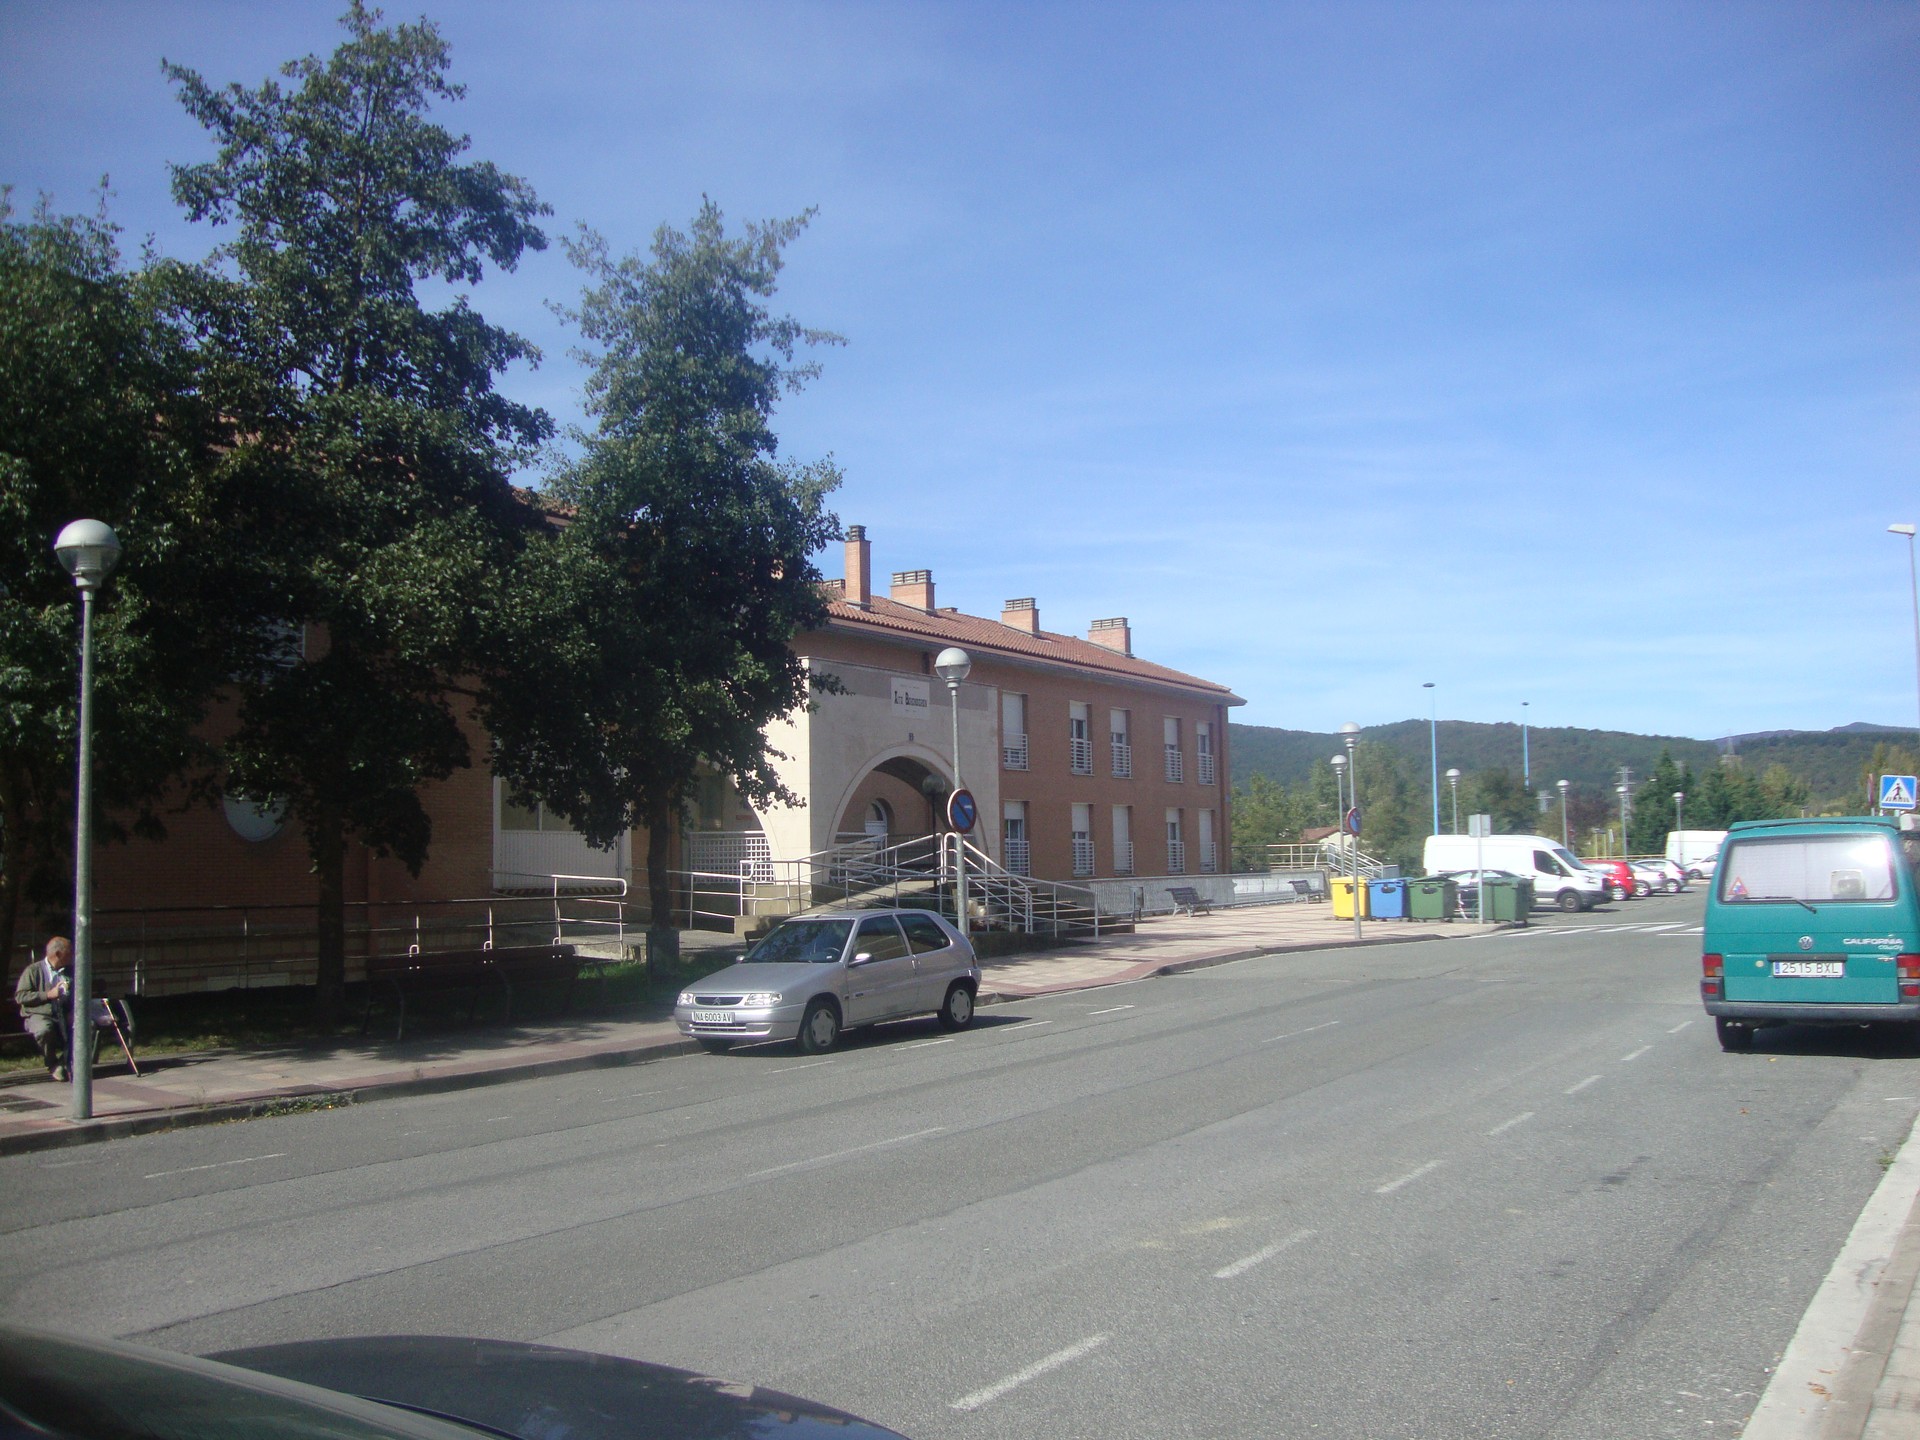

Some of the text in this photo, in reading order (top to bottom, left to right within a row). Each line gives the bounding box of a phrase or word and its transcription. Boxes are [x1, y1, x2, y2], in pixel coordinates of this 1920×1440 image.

[1782, 961, 1839, 974] 2515 BXL
[695, 1013, 731, 1022] NA 6003 AV
